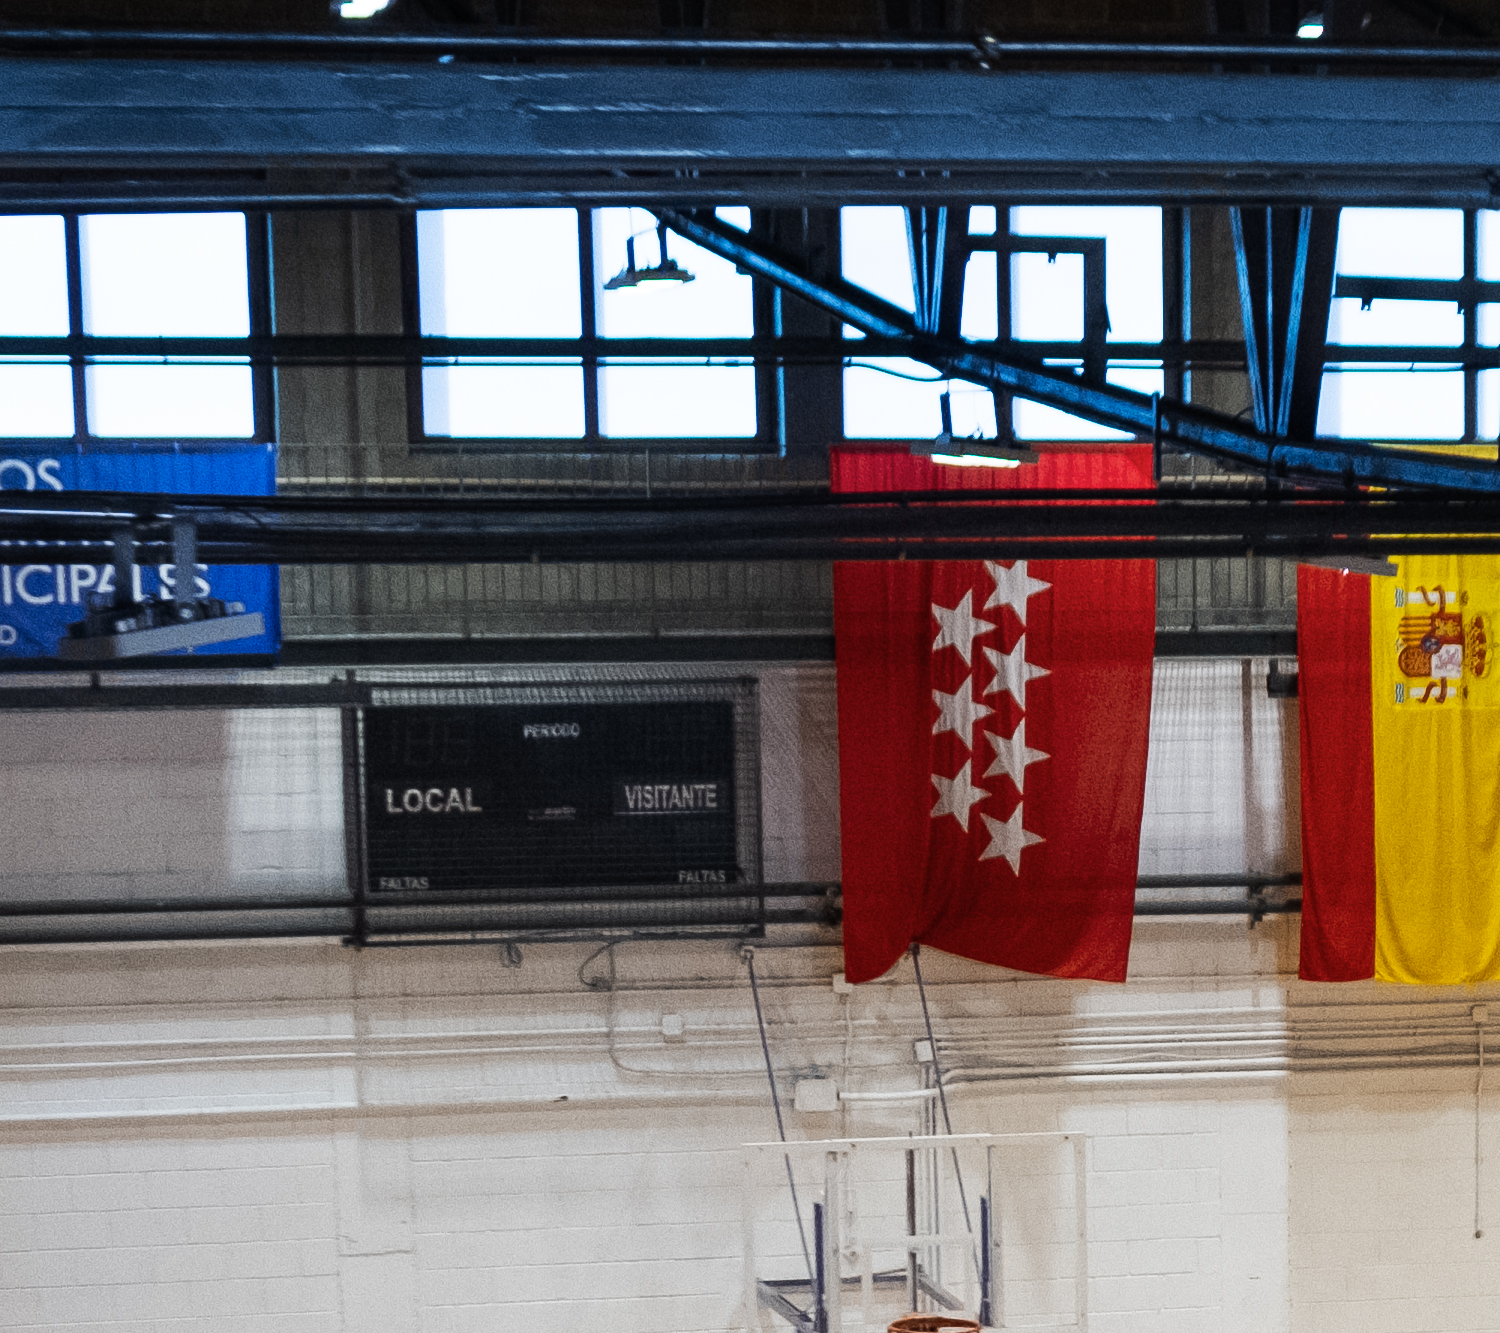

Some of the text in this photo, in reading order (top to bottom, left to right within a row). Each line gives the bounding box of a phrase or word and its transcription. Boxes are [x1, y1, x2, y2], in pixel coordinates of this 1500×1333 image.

[524, 723, 580, 739] PERIODO
[386, 787, 483, 814] LOCAL
[625, 783, 718, 811] VISITANTE
[379, 876, 430, 891] FALTAS
[679, 869, 727, 884] FALTAS
